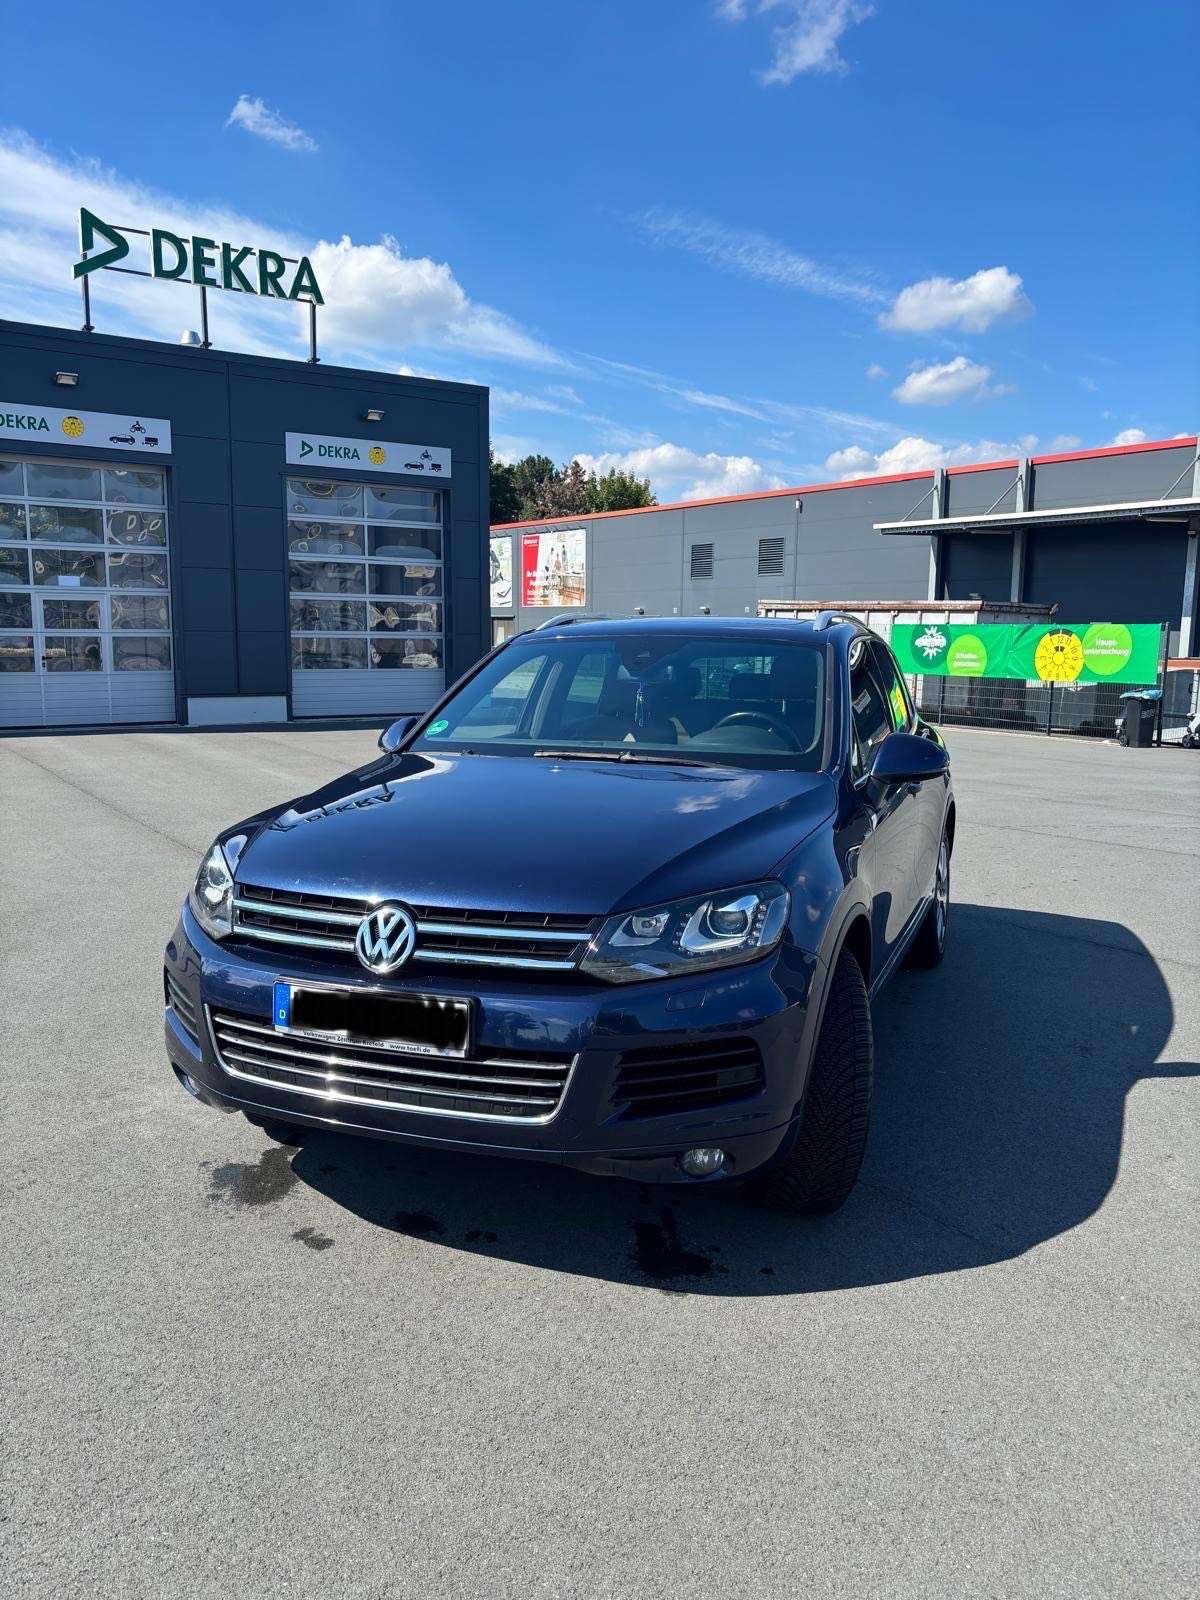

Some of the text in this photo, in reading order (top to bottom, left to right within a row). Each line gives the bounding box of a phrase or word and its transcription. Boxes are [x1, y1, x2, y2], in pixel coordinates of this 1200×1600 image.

[150, 228, 325, 305] DEKRA
[318, 444, 361, 461] DEKRA
[279, 1009, 286, 1019] D
